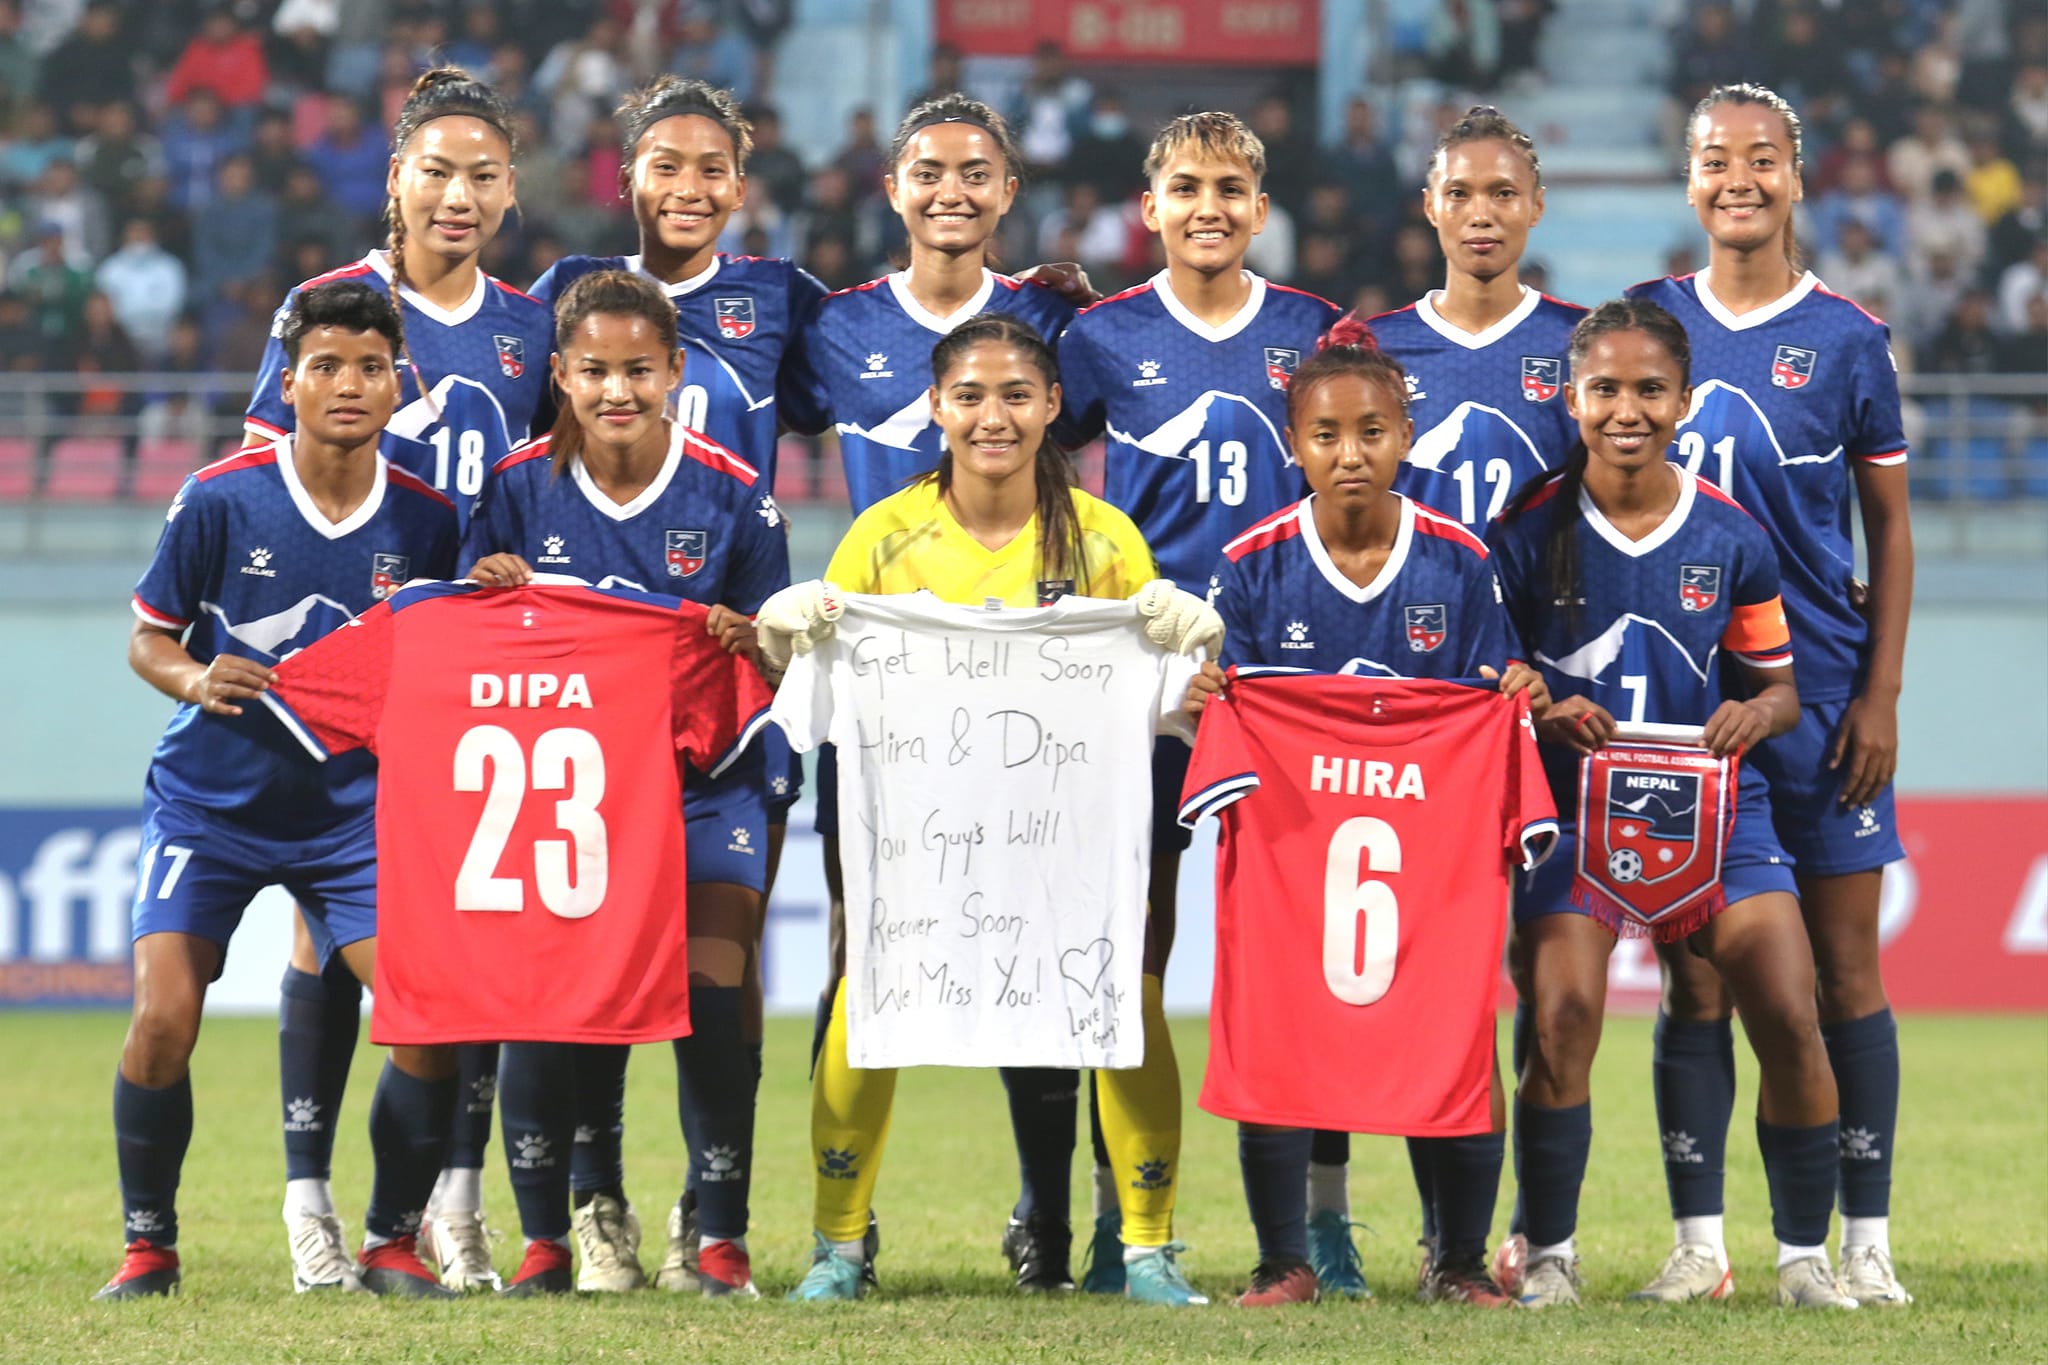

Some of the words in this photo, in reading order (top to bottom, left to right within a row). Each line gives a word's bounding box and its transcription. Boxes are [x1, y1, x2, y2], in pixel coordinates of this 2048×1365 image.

[429, 426, 484, 496] 18
[1188, 440, 1248, 507] 13
[1453, 457, 1512, 524] 12
[1678, 431, 1735, 498] 21
[852, 631, 917, 700] Get
[945, 636, 1010, 679] Well
[1038, 636, 1114, 694] Soon
[1280, 641, 1316, 650] KELME
[469, 673, 594, 709] DIPA
[1620, 674, 1648, 723] 7
[857, 714, 928, 777] Hira
[948, 706, 973, 766] &
[986, 710, 1090, 793] Dipa
[1310, 755, 1427, 801] HIRA
[1626, 775, 1681, 792] NEPAL
[453, 724, 609, 919] 23
[858, 804, 906, 873] You
[1007, 809, 1061, 847] Will
[137, 844, 195, 903] 17
[1322, 816, 1403, 1007] 6
[918, 961, 973, 1006] Miss
[994, 955, 1042, 1008] You!
[1066, 1006, 1101, 1038] Love
